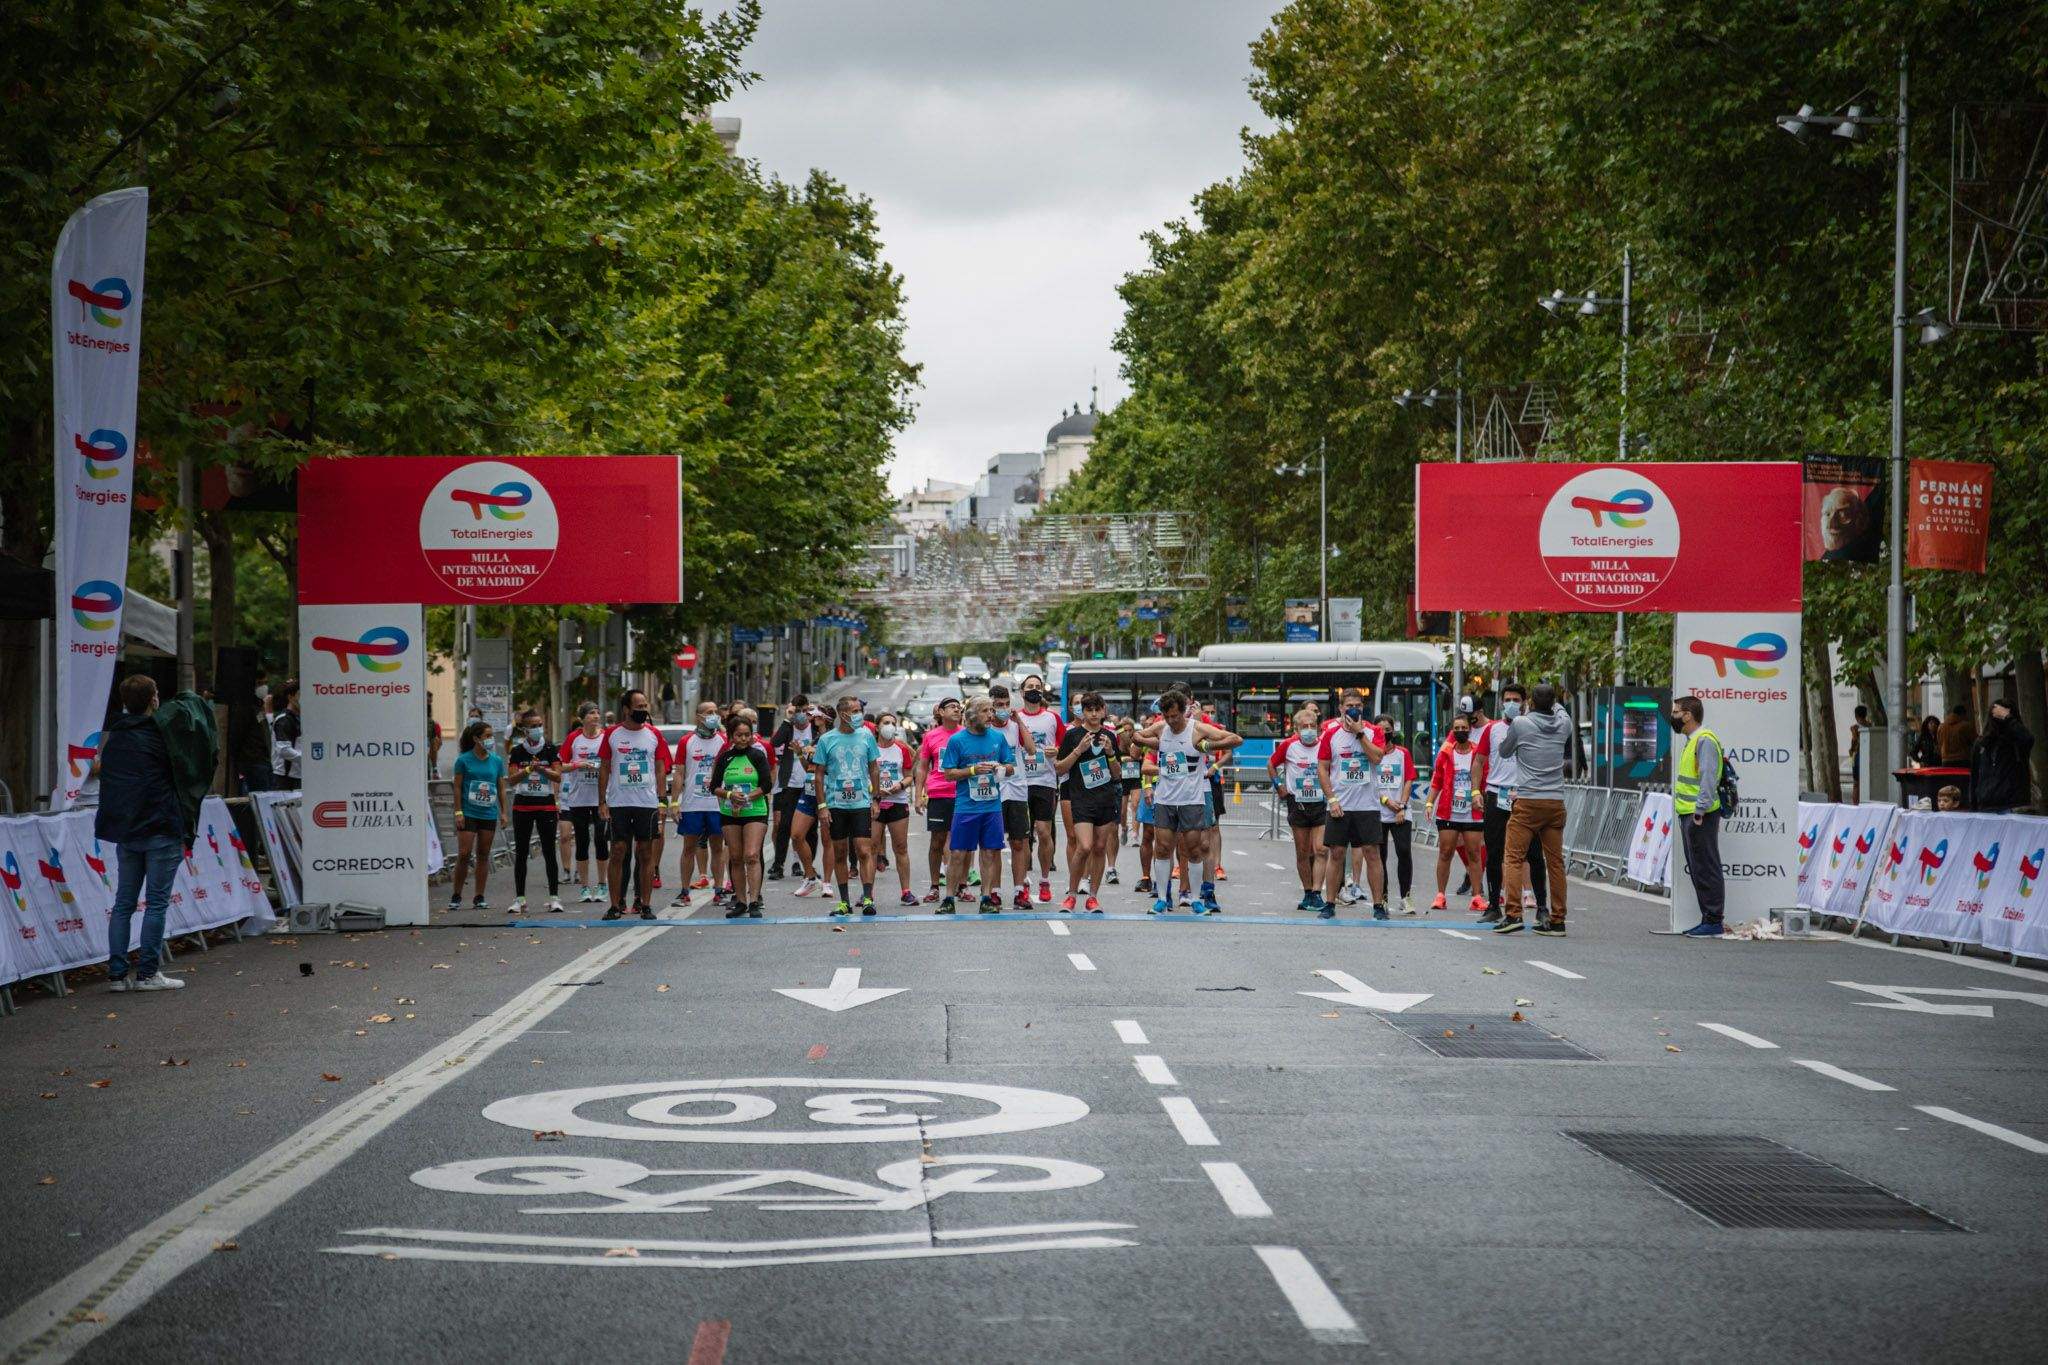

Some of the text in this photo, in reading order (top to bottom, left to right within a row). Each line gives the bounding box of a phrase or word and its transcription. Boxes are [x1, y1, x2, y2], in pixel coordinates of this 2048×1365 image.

[1920, 480, 1983, 495] FERNÁN
[1920, 491, 1982, 509] GÓMEZ
[451, 528, 533, 541] TotalEnergies
[1571, 536, 1654, 548] TotalEnergies
[471, 553, 510, 563] MILLA
[1590, 560, 1629, 570] MILLA
[457, 576, 525, 587] DE MADRID
[1576, 584, 1644, 595] DE MADRID
[312, 682, 411, 697] TotalEnergies
[1689, 687, 1788, 703] TotalEnergies
[336, 742, 415, 757] MADRID
[1722, 748, 1790, 763] ADRID
[1025, 764, 1037, 772] 547
[628, 773, 642, 783] 303
[842, 791, 857, 800] 395
[1301, 789, 1317, 798] 1001
[352, 800, 405, 812] MILLA
[352, 814, 413, 828] URBANA
[1725, 820, 1786, 834] URBANA
[626, 1093, 942, 1126] 30
